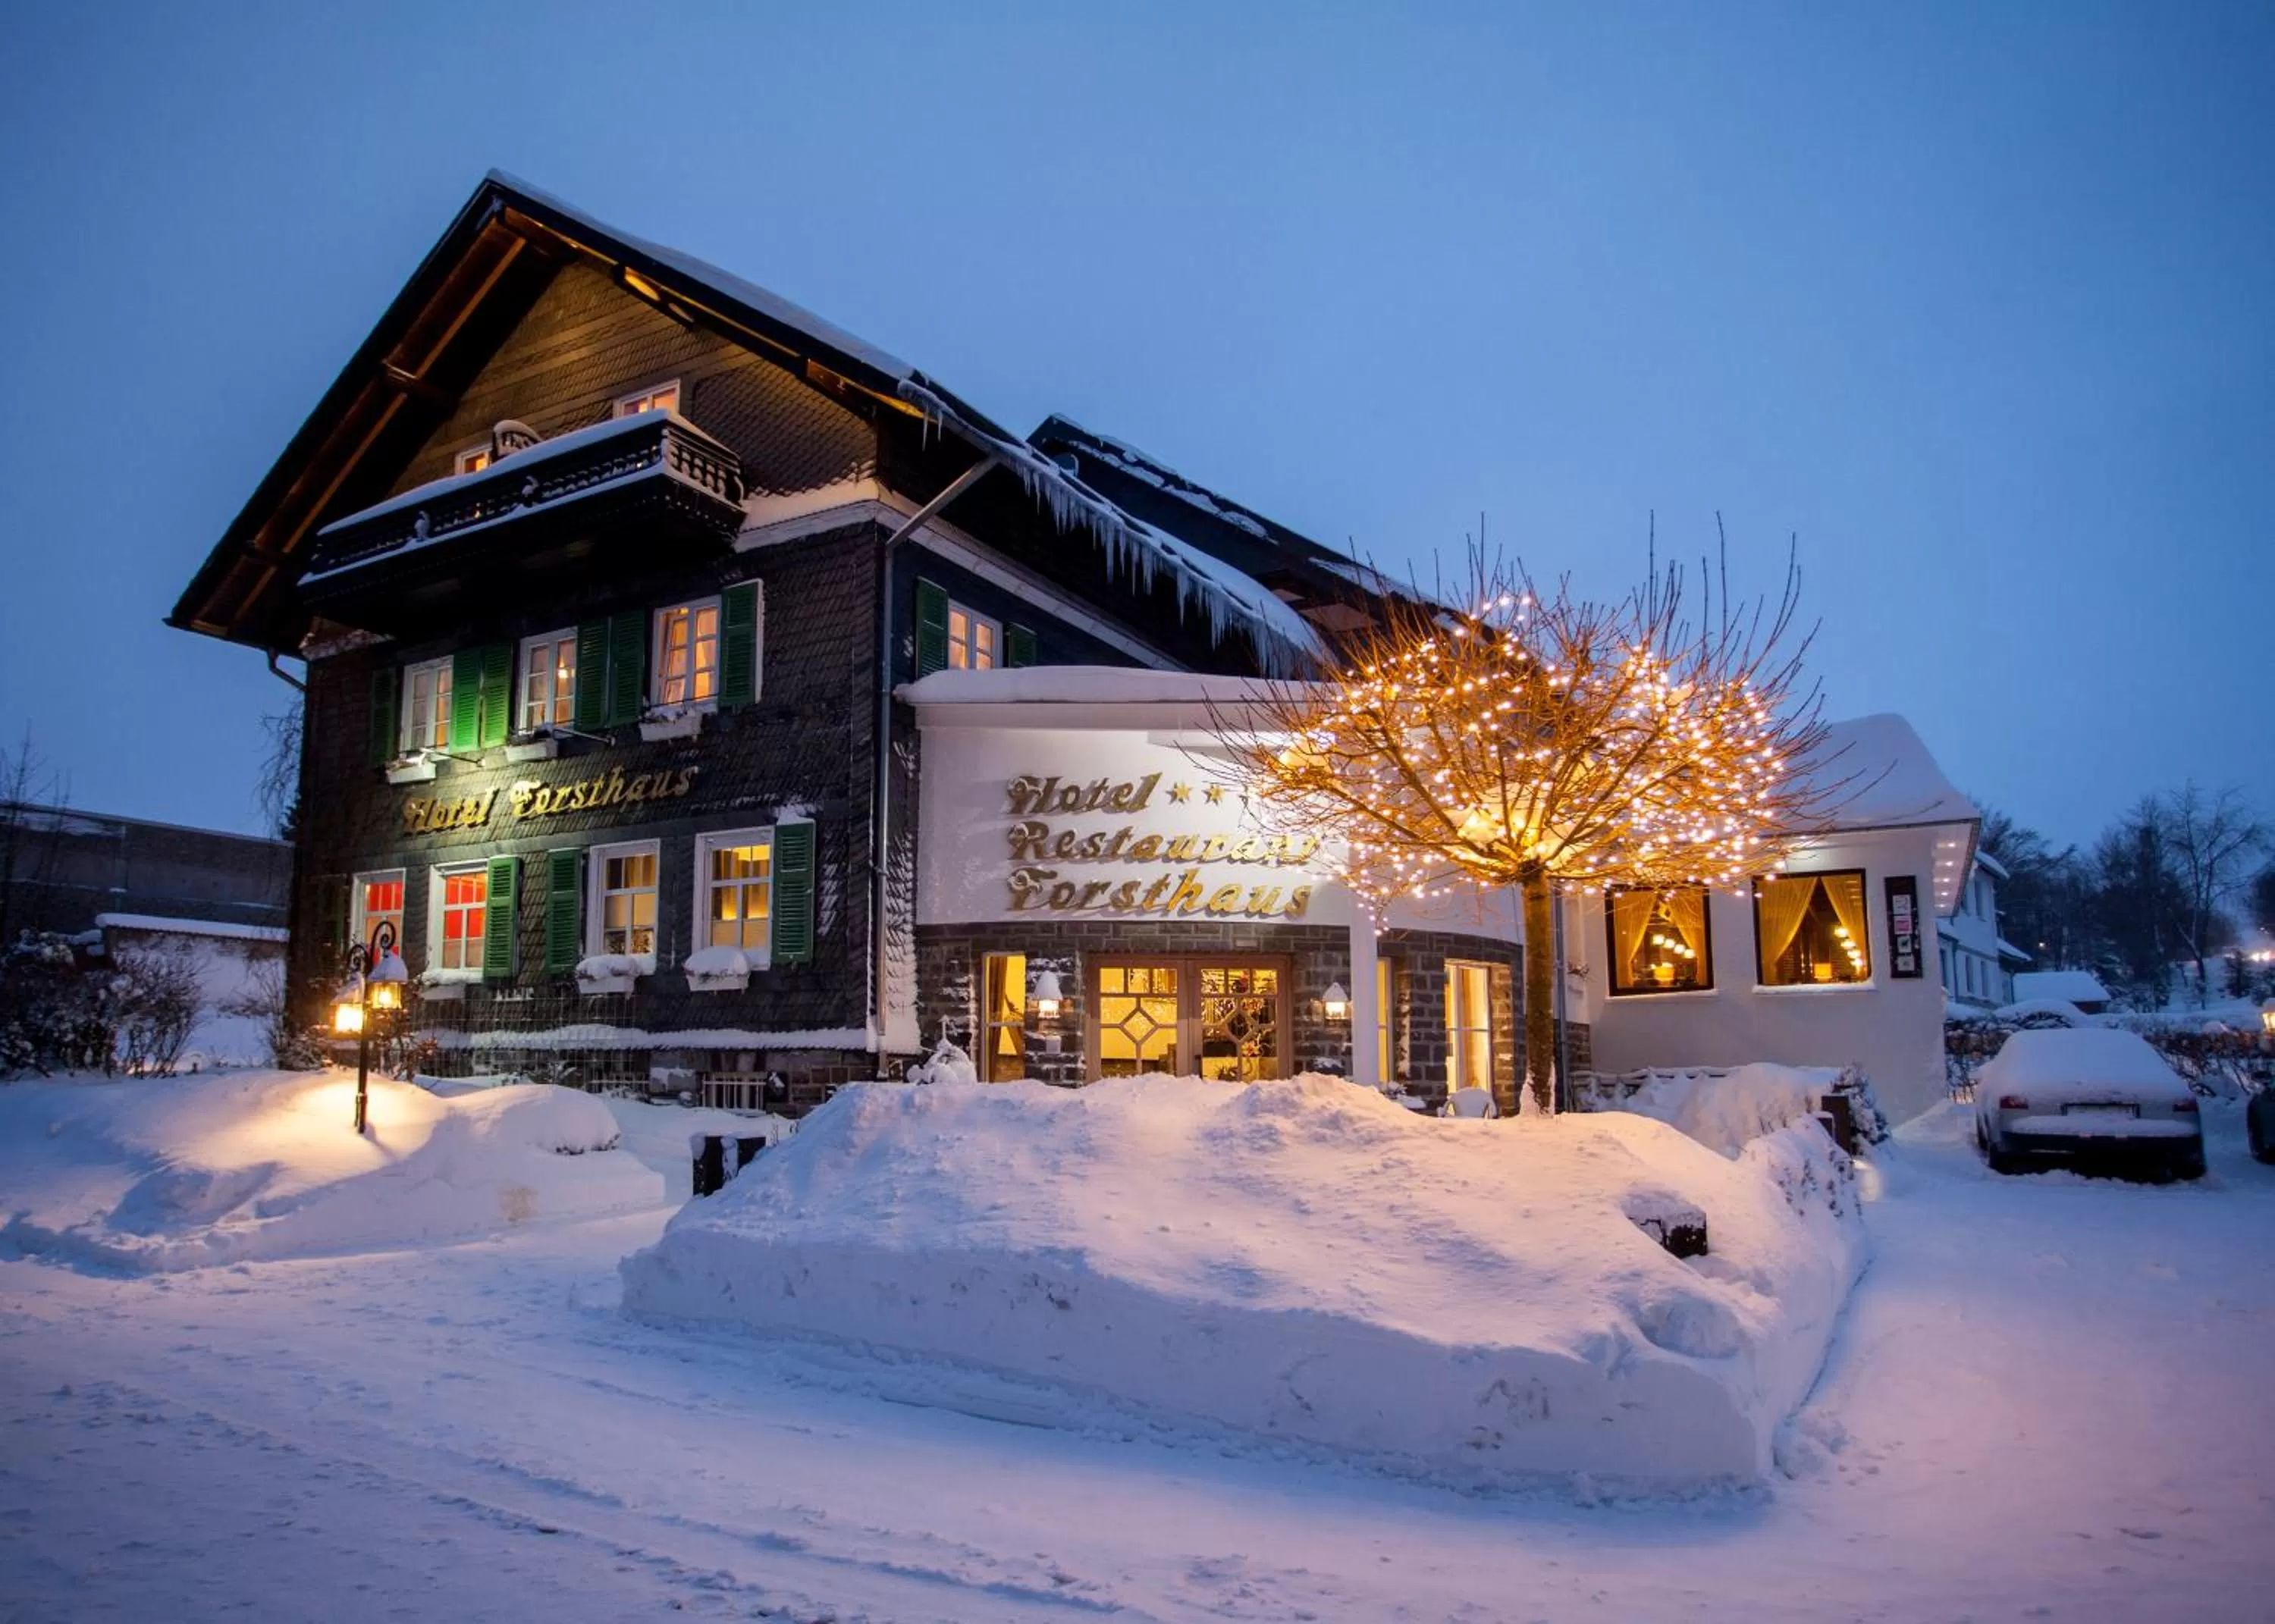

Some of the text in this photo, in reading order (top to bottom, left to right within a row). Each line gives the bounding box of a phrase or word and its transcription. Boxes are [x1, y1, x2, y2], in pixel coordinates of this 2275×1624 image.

[403, 764, 699, 833] Hotel Forsthaus
[1006, 771, 1163, 815] Hotel
[1006, 867, 1313, 917] Forsthaus
